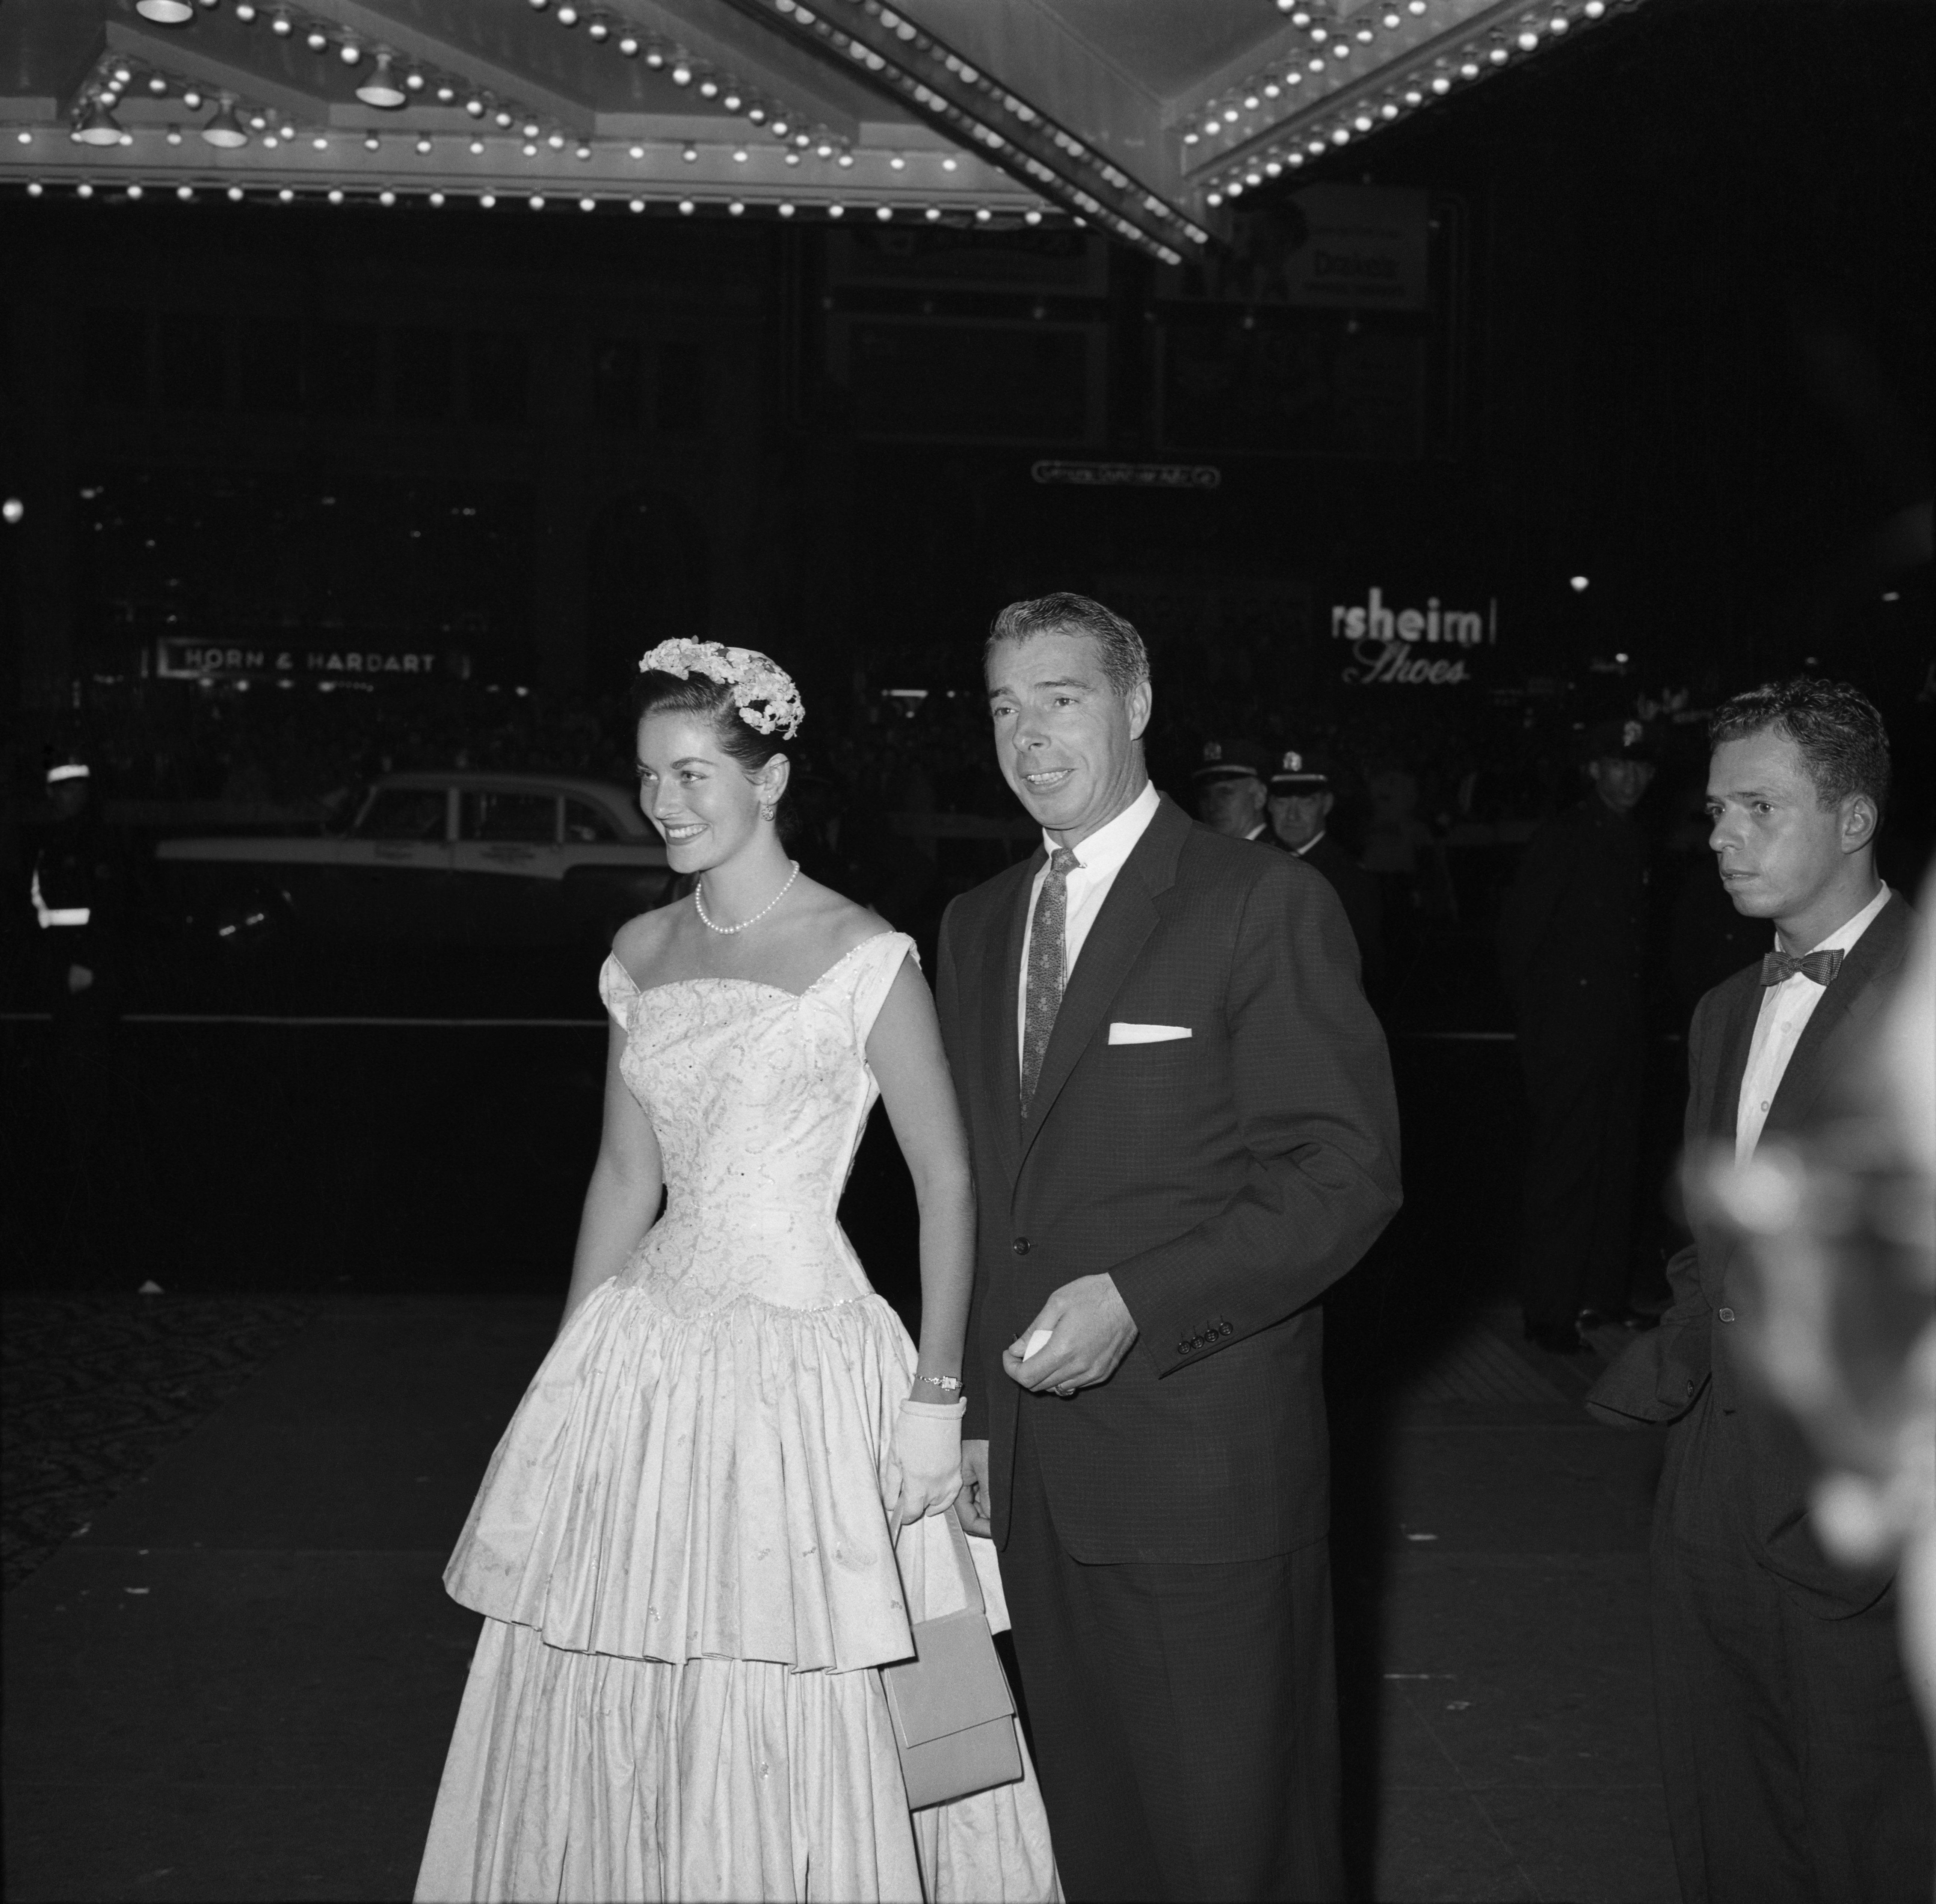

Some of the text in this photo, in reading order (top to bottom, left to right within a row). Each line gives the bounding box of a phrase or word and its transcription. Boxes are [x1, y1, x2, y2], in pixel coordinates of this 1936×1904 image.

[1332, 586, 1482, 642] rsheim
[185, 648, 435, 672] HORN & HARDART
[1341, 638, 1470, 685] Shoes
